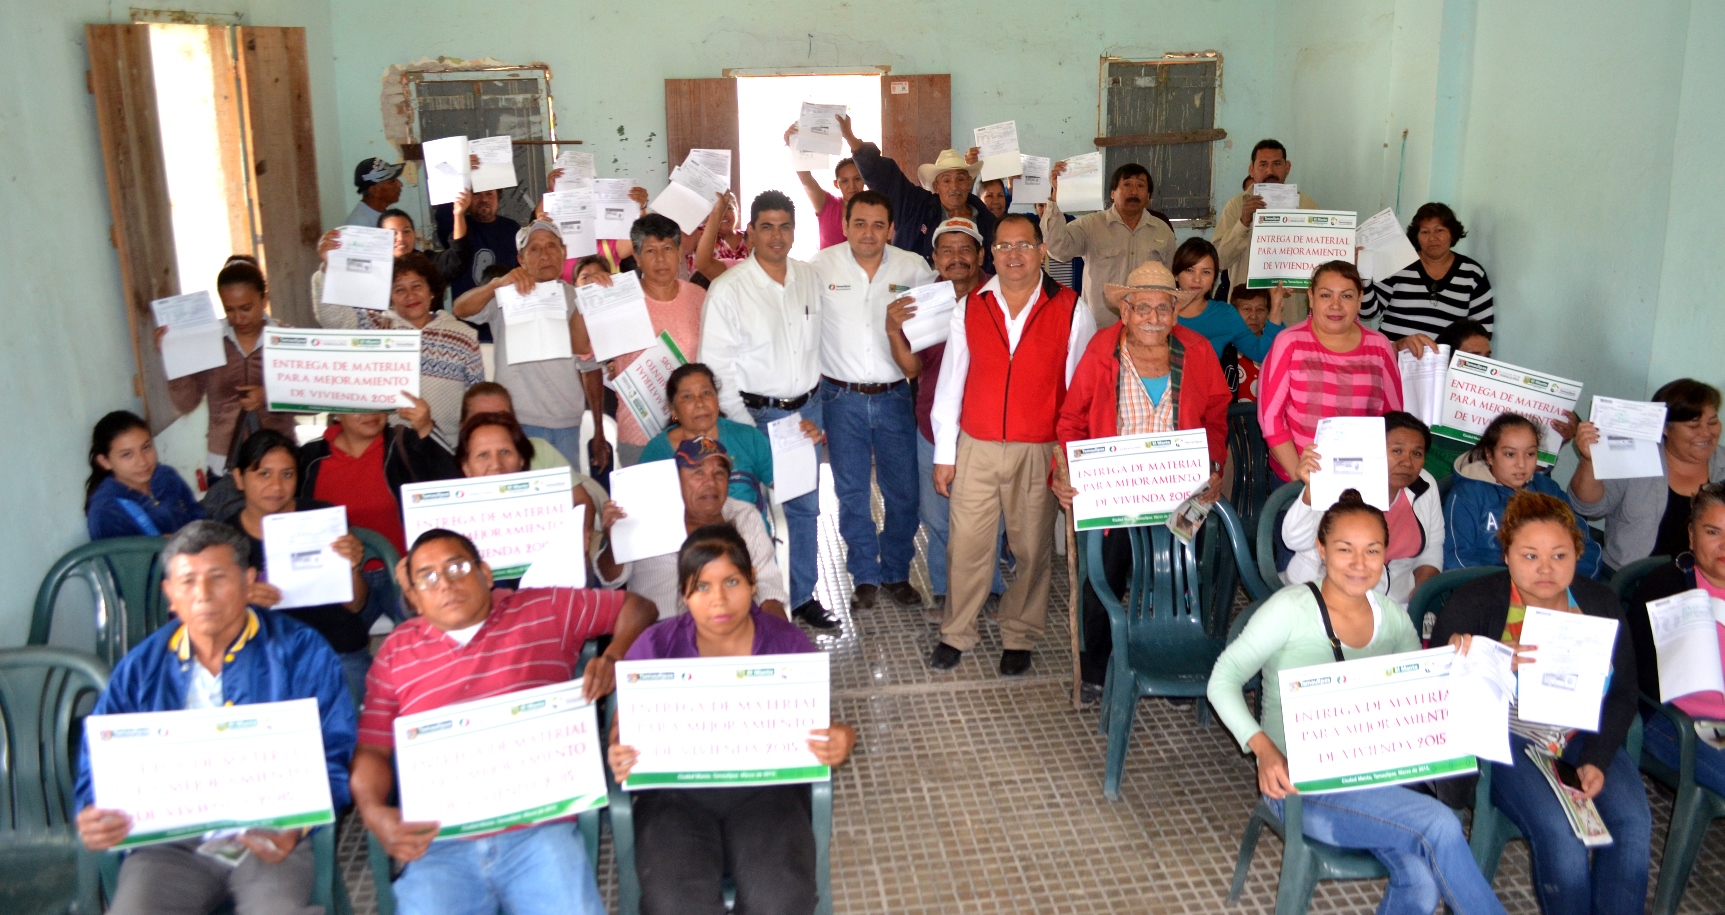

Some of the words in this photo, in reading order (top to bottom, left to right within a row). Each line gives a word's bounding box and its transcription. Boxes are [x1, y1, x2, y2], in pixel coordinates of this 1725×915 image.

[1256, 235, 1291, 243] ENTREGA
[1306, 236, 1350, 245] MATERIAL
[1279, 248, 1347, 257] MEJORAMIENTO
[1263, 262, 1272, 270] DE
[1274, 262, 1315, 271] VIVIENDA
[273, 359, 329, 371] ENTREGA
[333, 362, 348, 371] DE
[352, 361, 412, 372] MATERIAL
[277, 373, 309, 383] PARA
[313, 375, 409, 386] MEJORAMIENTO
[290, 389, 305, 398] DE
[310, 390, 368, 403] VIVIENDA
[371, 394, 397, 404] 2015
[1450, 379, 1497, 399] ENTREGA
[1500, 391, 1514, 403] DE
[1450, 392, 1476, 407] PARA
[1454, 410, 1467, 421] DE
[1131, 463, 1145, 473] DE
[1148, 459, 1203, 471] MATERIAL
[1083, 481, 1112, 492] PARA
[1115, 473, 1201, 488] MEJORAMIENTO
[1113, 493, 1166, 506] VIVIENDA
[1169, 490, 1192, 501] 2015
[416, 514, 476, 529] ENTREGA
[481, 512, 495, 522] DE
[502, 504, 565, 520] MATERIAL
[1389, 689, 1449, 708] MATERIA
[1302, 725, 1340, 741] PARA
[1417, 732, 1447, 749] 2015
[766, 742, 798, 754] 2015
